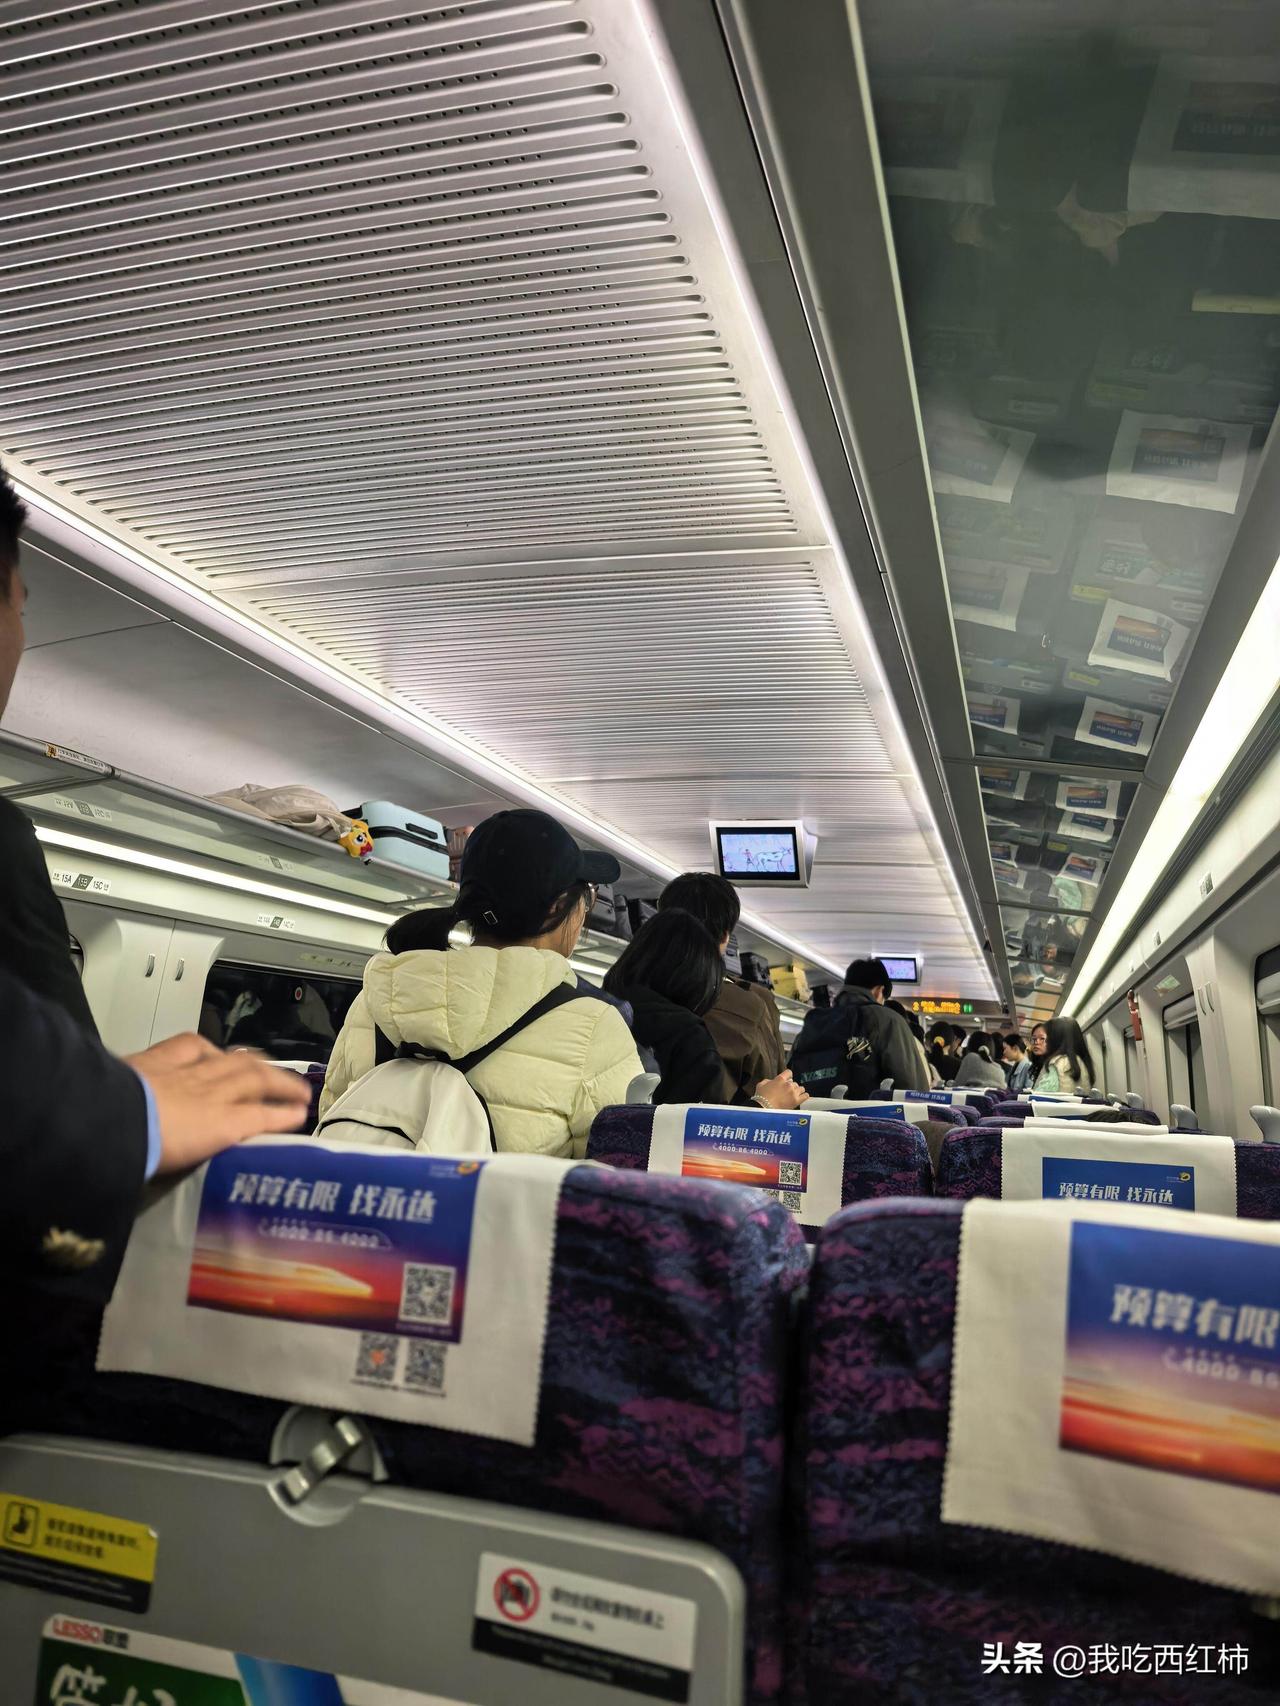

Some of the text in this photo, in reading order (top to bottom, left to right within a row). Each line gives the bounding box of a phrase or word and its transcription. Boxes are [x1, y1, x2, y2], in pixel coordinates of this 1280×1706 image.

[61, 873, 72, 884] 15A
[93, 880, 104, 890] 15C
[697, 1123, 793, 1146] 预算有限 找永达
[229, 1172, 438, 1224] 预算有限 找永达
[1058, 1182, 1174, 1205] 预算有限 找永达
[1110, 1283, 1280, 1348] 预算有限
